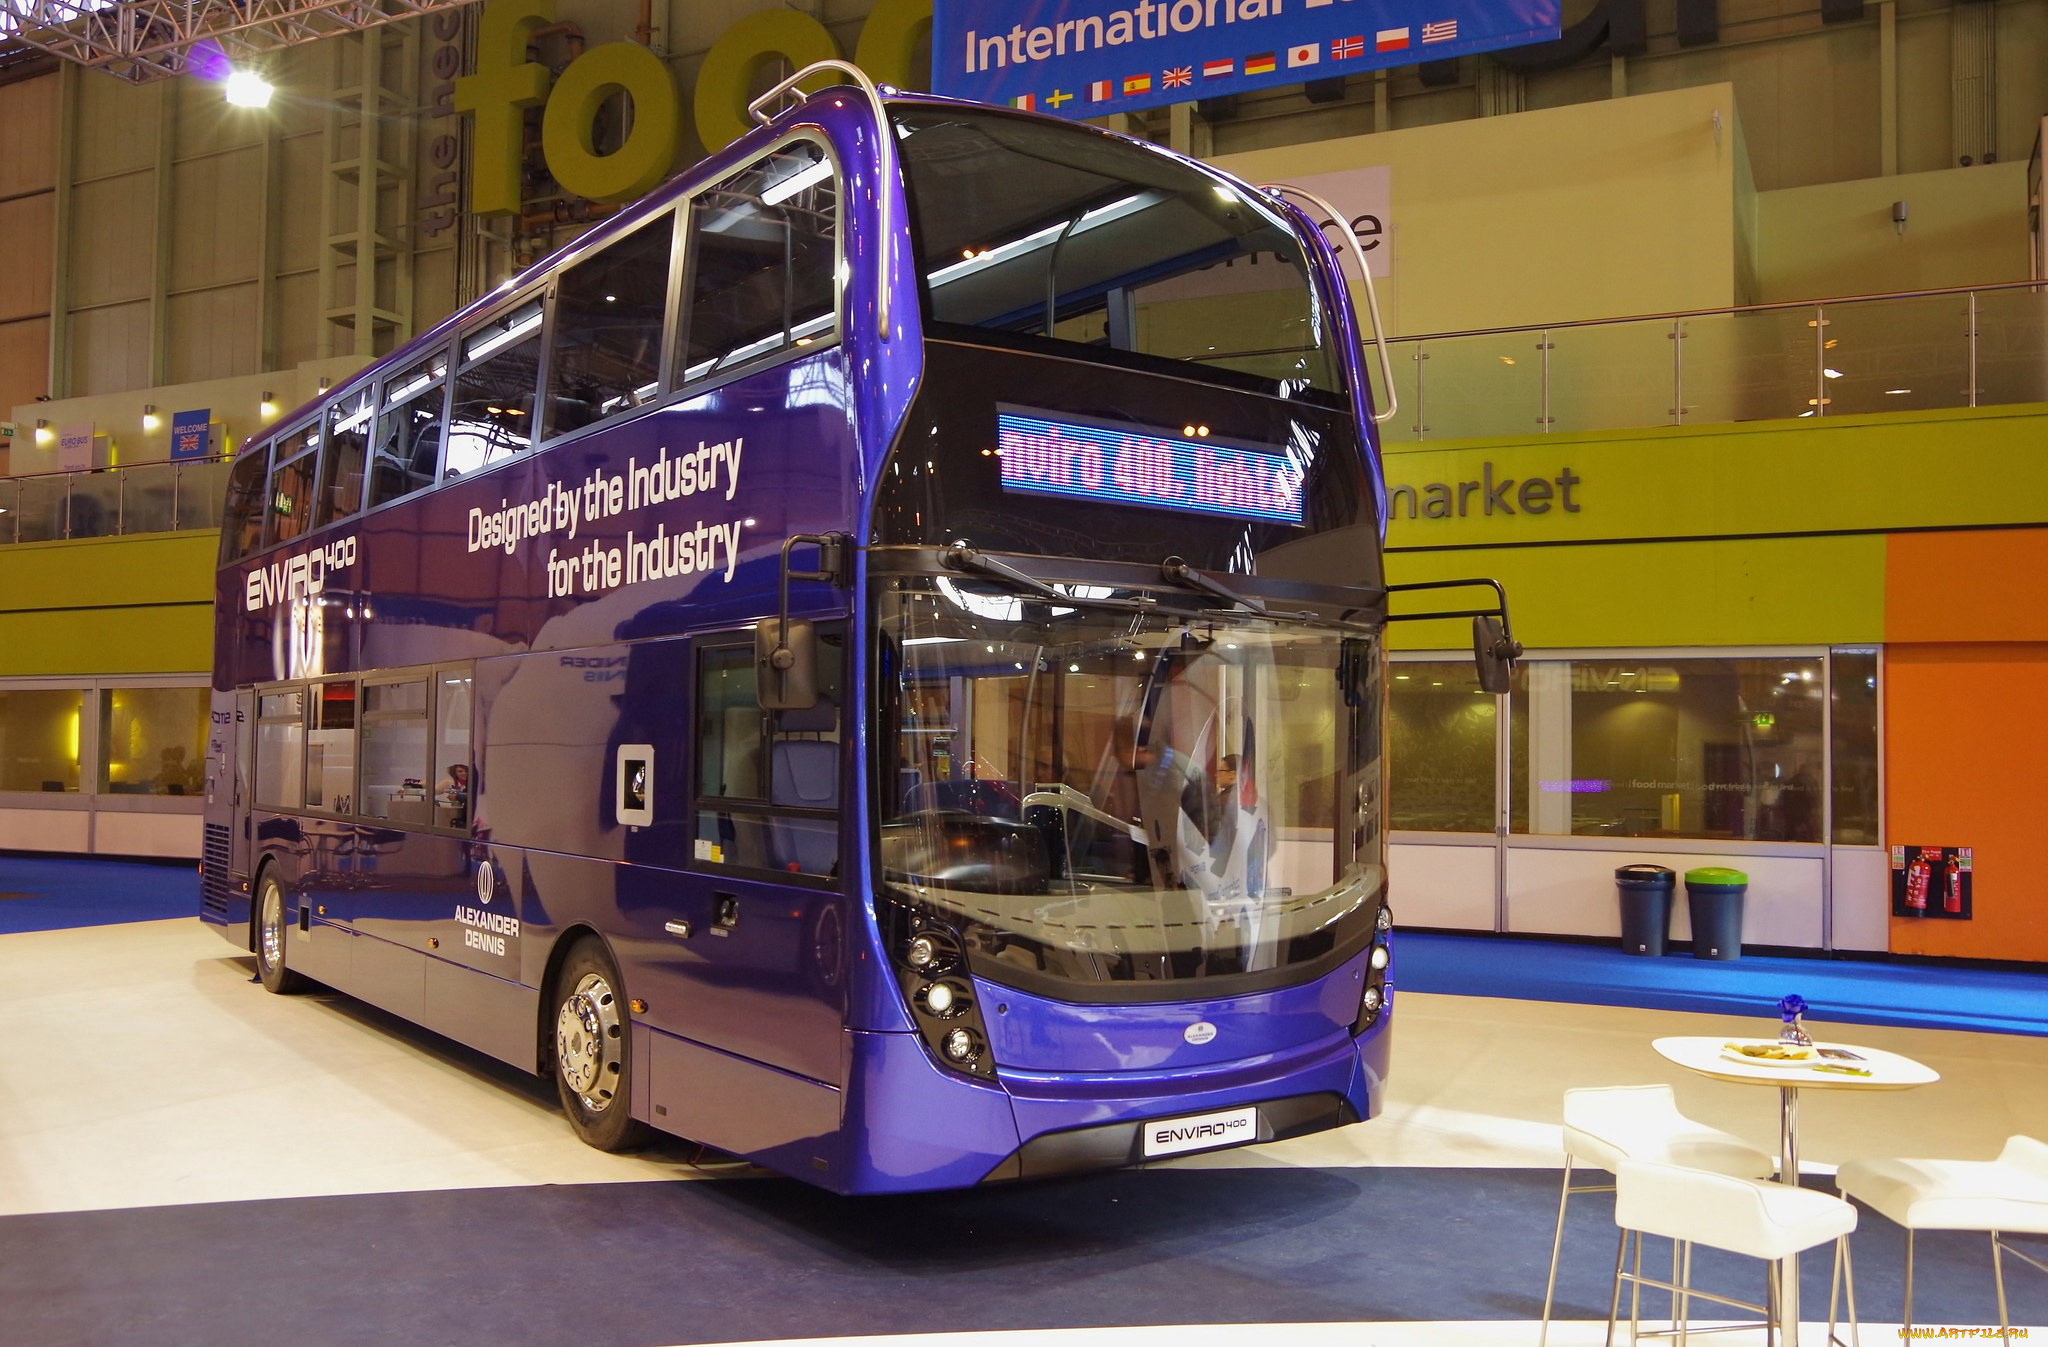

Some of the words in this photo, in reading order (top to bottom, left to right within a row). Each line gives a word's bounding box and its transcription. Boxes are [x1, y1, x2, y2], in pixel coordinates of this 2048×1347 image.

[61, 437, 77, 447] EURO
[77, 436, 88, 445] BUS
[173, 423, 208, 435] WELCOME
[468, 483, 551, 555] Designed
[555, 480, 581, 540] by
[584, 468, 623, 522] the
[628, 437, 743, 511] Industry
[547, 549, 579, 598] for
[582, 539, 621, 592] the
[626, 520, 741, 583] Industry
[454, 904, 519, 938] ALEXANDER
[465, 928, 505, 957] DENNIS
